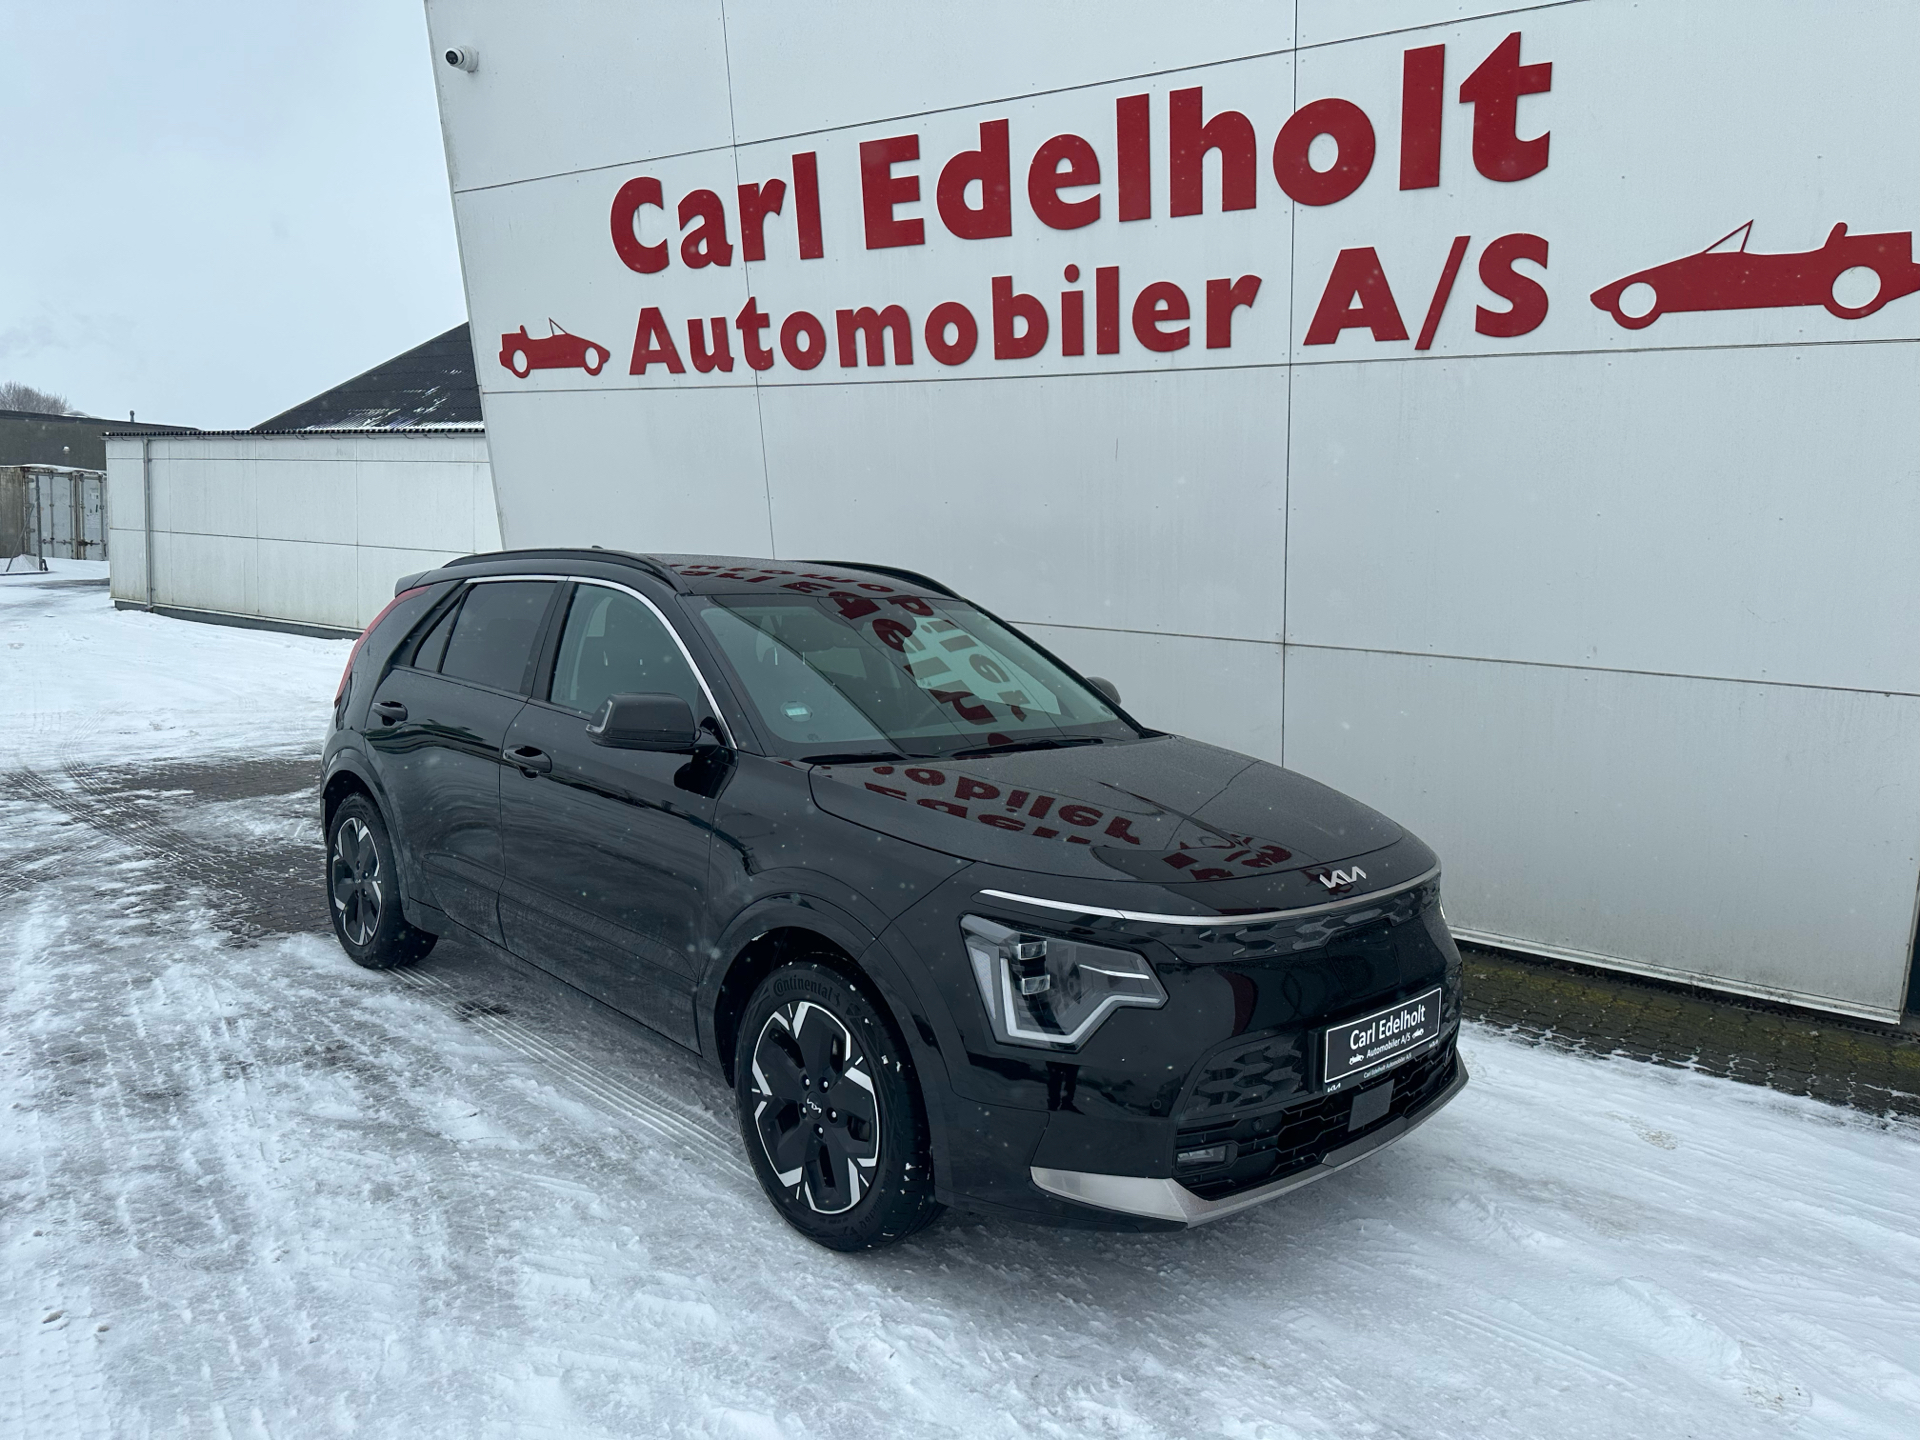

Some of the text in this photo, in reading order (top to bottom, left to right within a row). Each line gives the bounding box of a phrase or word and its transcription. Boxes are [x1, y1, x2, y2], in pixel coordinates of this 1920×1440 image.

[610, 31, 1552, 274] Carl Edelholt
[629, 233, 1549, 375] Automobiler A/S
[773, 974, 833, 1002] Continental
[1350, 1004, 1426, 1050] Carl Edelholt
[1366, 1032, 1411, 1058] Automobiler A/S
